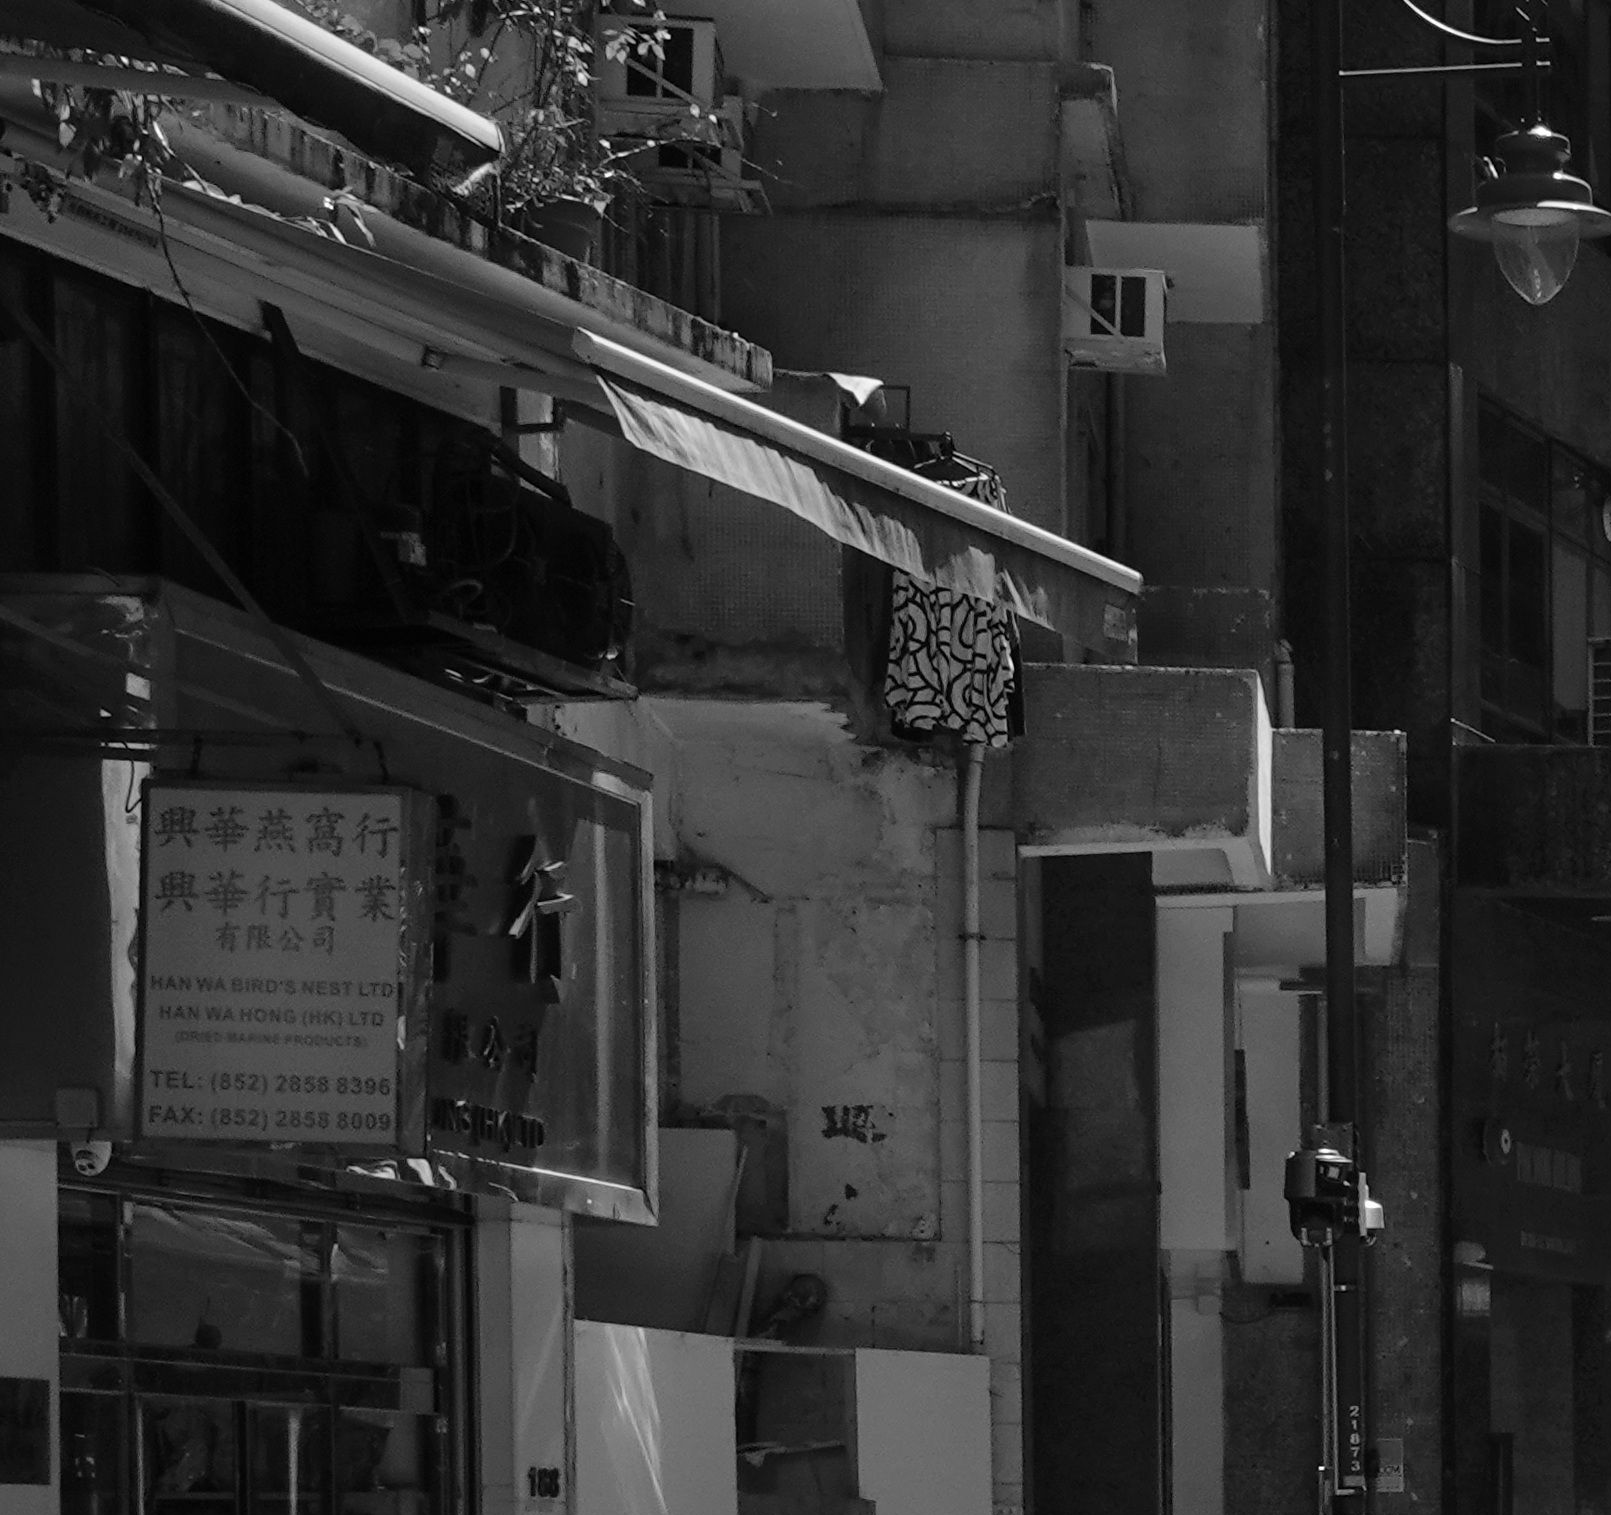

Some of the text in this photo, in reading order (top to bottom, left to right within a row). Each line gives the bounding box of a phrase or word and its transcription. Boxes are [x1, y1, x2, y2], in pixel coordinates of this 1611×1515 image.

[154, 806, 399, 858] 興華燕窩行
[153, 866, 396, 922] 興華行實業
[215, 920, 335, 956] 有限公司
[150, 974, 393, 998] HAN WA BIRD'S NEST LTD
[159, 1004, 384, 1028] HAN WA HONG (HK) LTD
[174, 1030, 222, 1044] (DRIED
[150, 1070, 391, 1096] TEL: (852) 2858 8396
[149, 1105, 391, 1131] FAX: (852) 2858 8009
